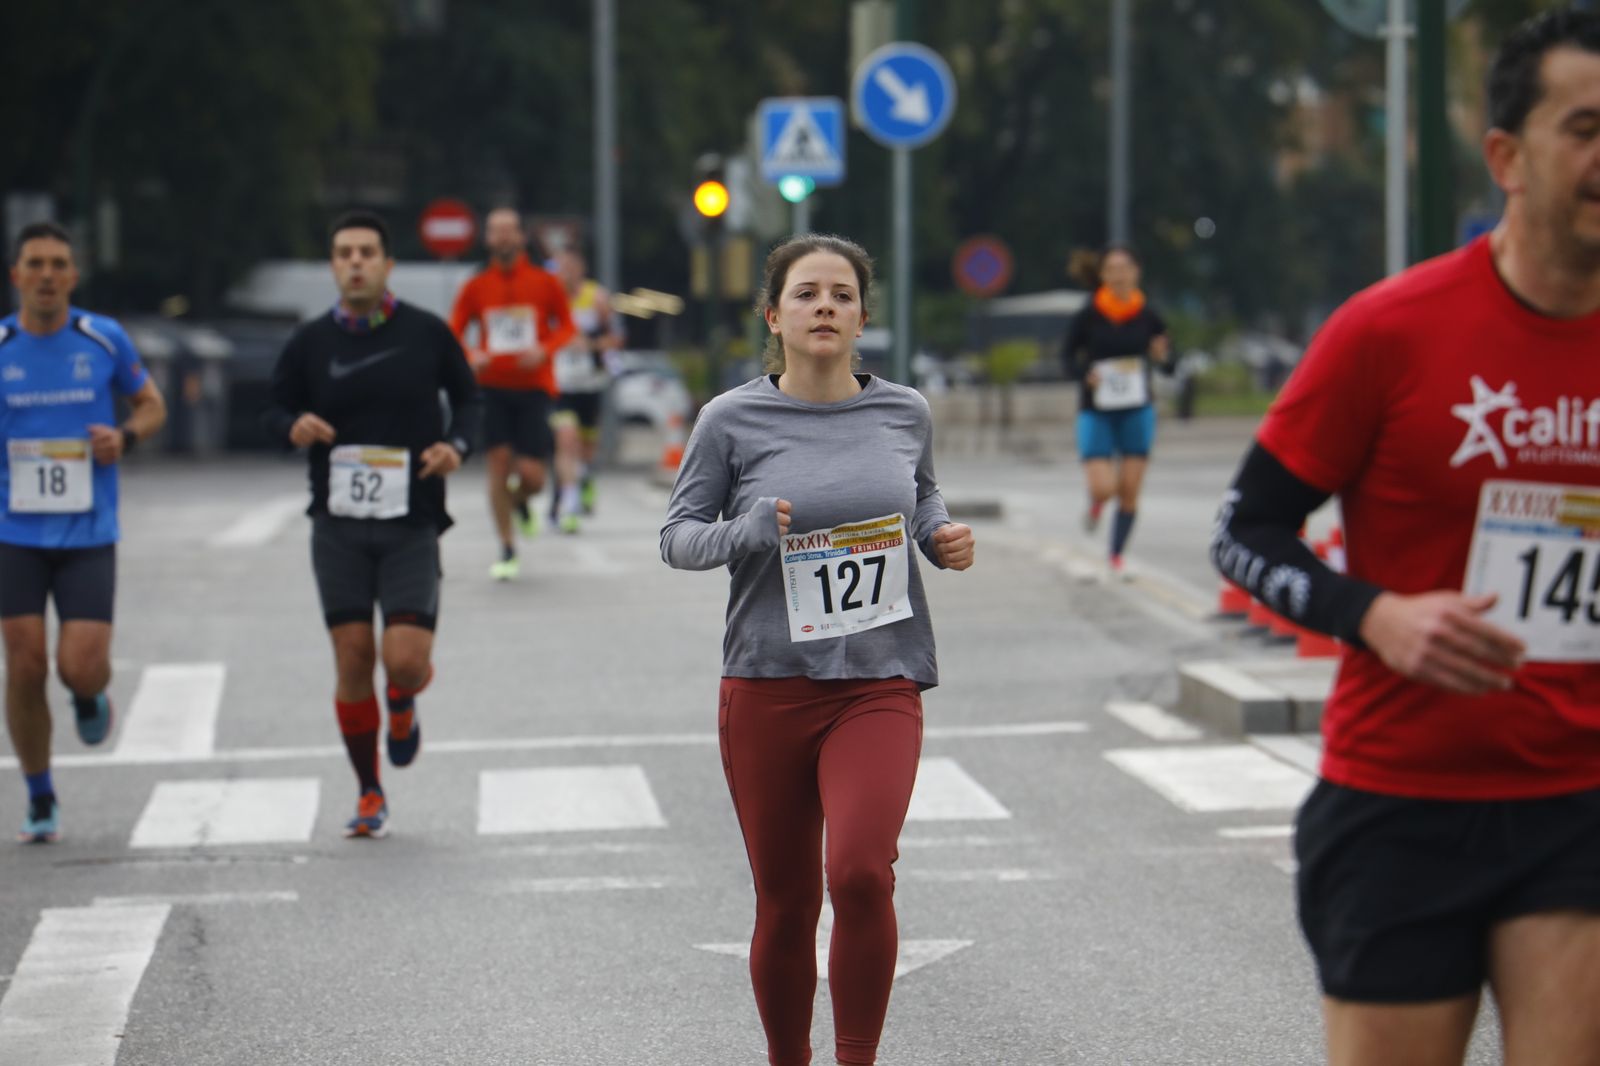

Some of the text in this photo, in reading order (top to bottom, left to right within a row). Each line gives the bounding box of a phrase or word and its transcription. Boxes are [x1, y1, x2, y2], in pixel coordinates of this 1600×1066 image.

[1502, 395, 1600, 447] calif
[38, 466, 66, 495] 18
[351, 472, 382, 502] 52
[786, 532, 831, 552] XXXIX
[825, 547, 847, 558] Trinidad
[852, 537, 903, 552] TRINITARIOS
[814, 554, 886, 614] 127
